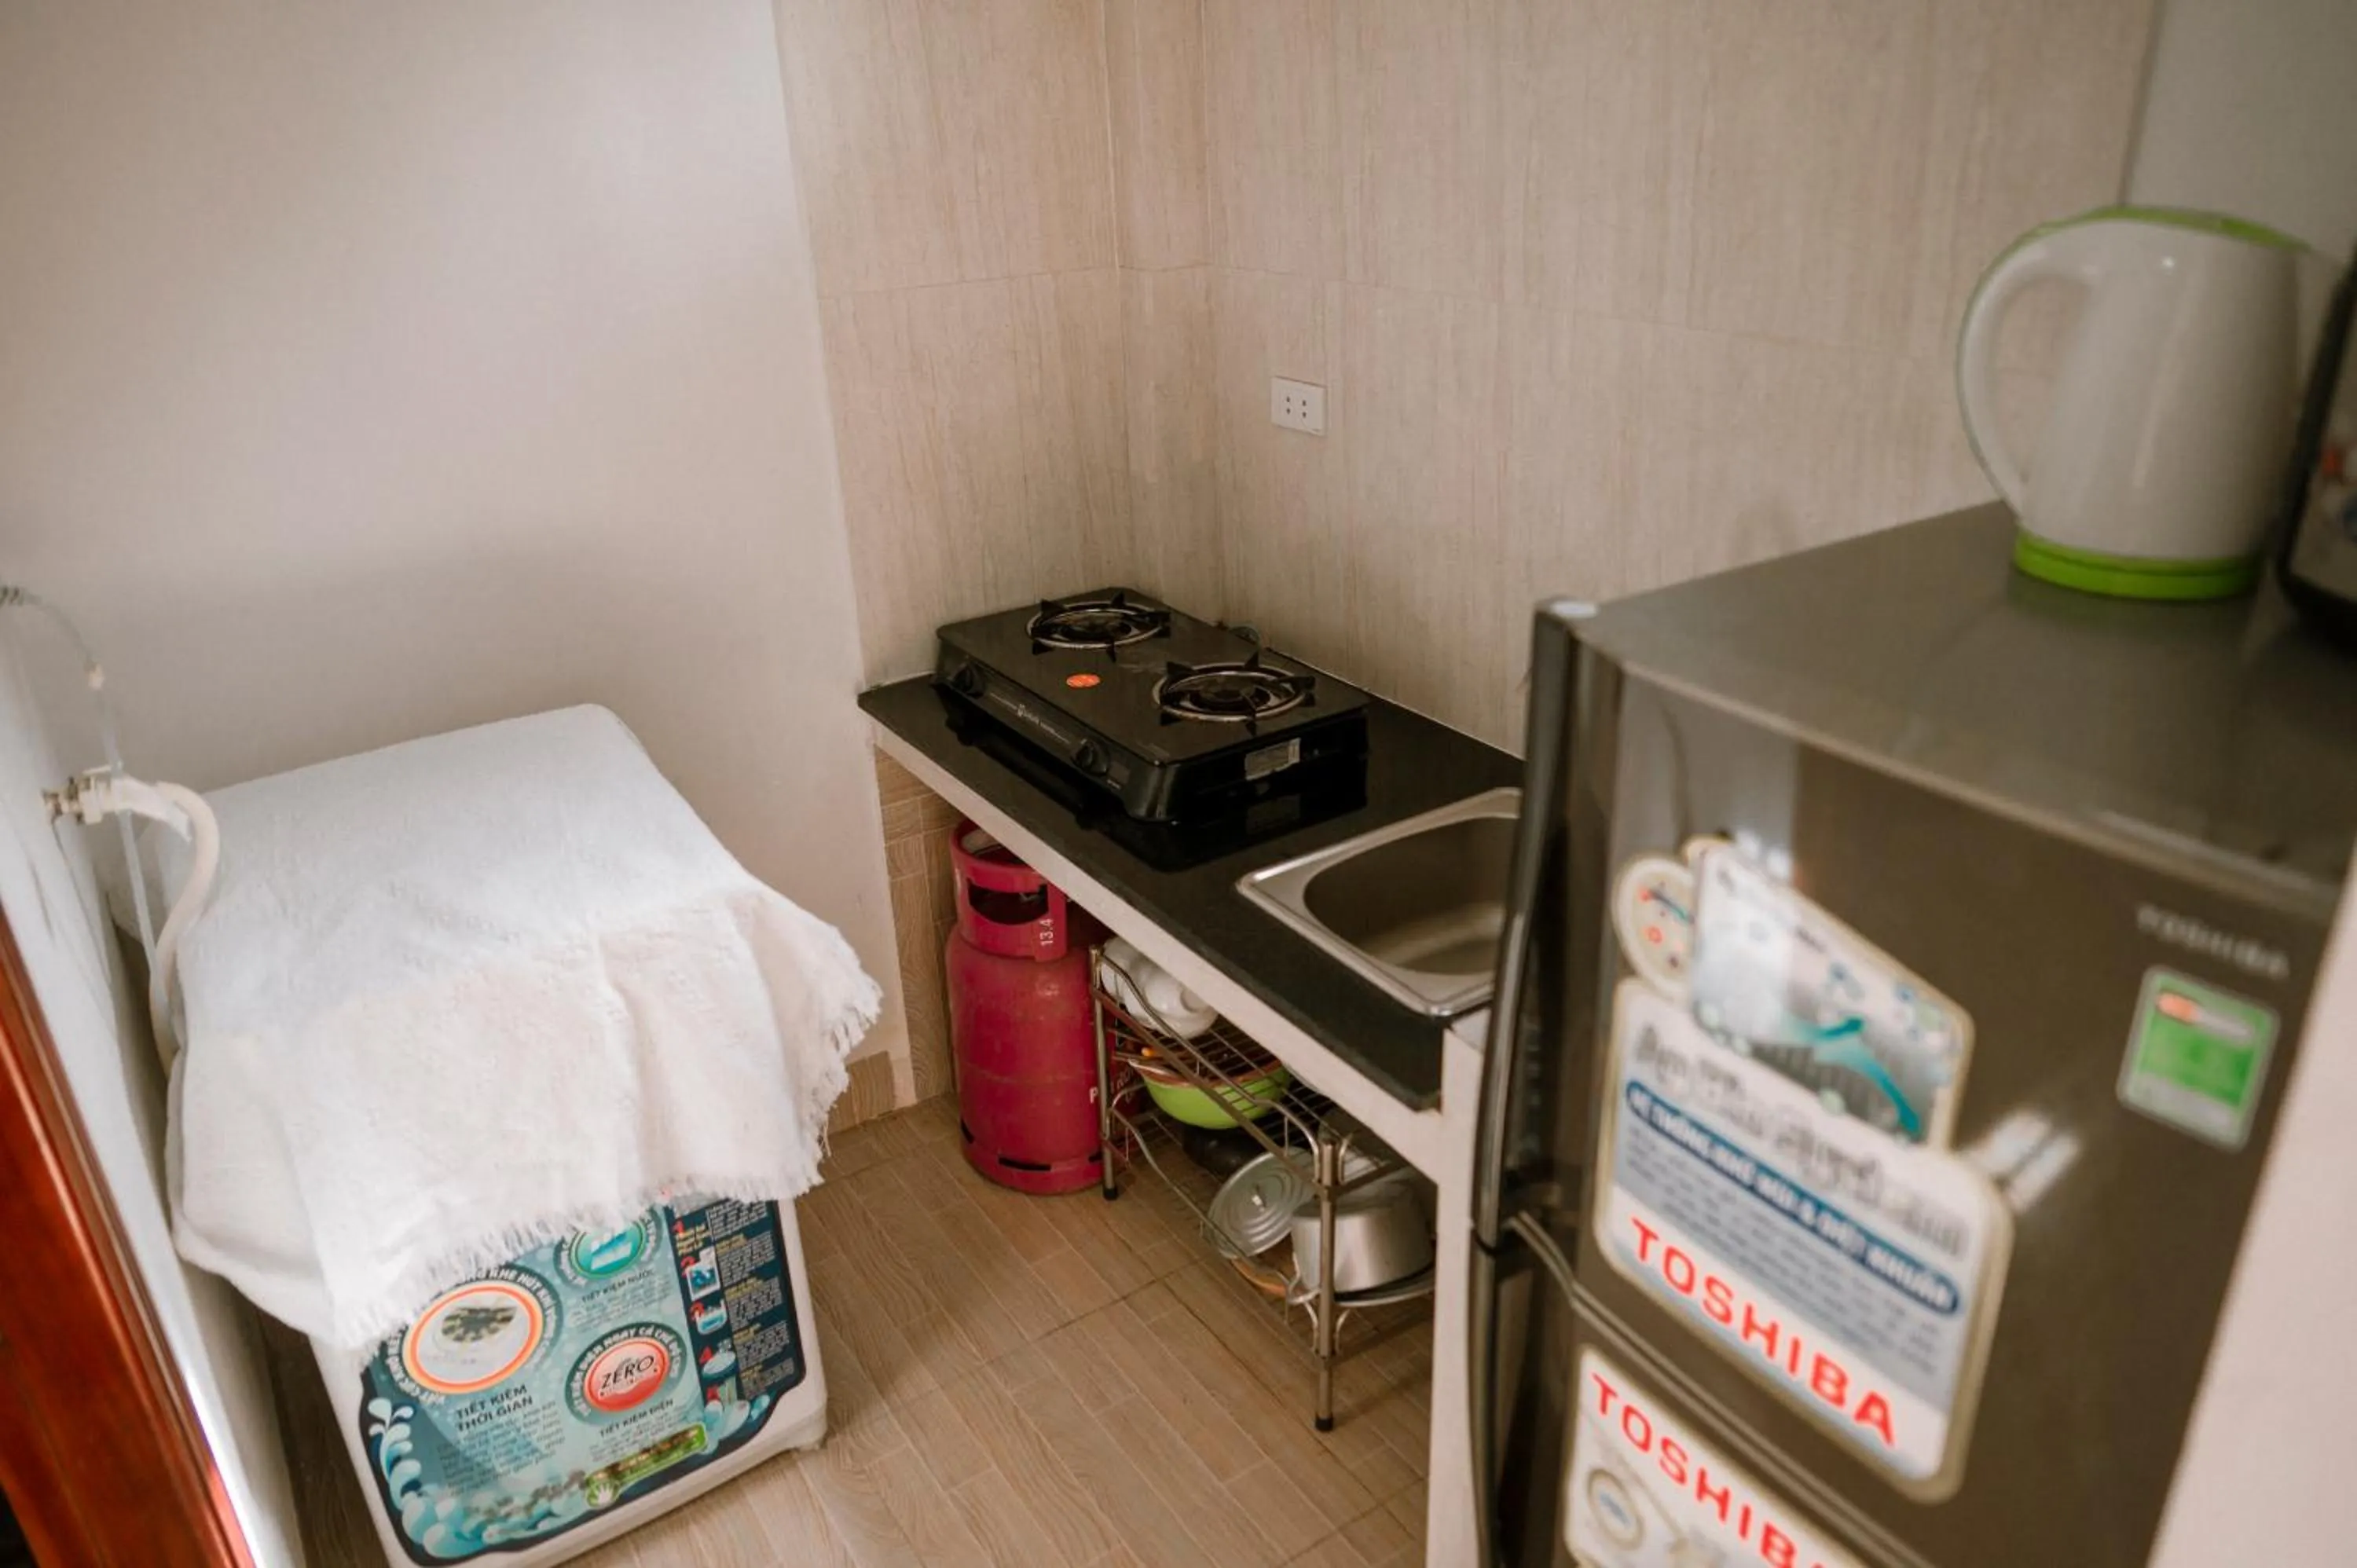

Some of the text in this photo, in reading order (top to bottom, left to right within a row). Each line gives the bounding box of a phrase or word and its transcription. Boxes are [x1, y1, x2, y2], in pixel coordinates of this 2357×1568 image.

[1039, 918, 1054, 946] 13.4
[601, 1355, 655, 1390] ZERO
[1630, 1215, 1897, 1448] TOSHIBA
[1592, 1372, 1827, 1568] TOSHIB
